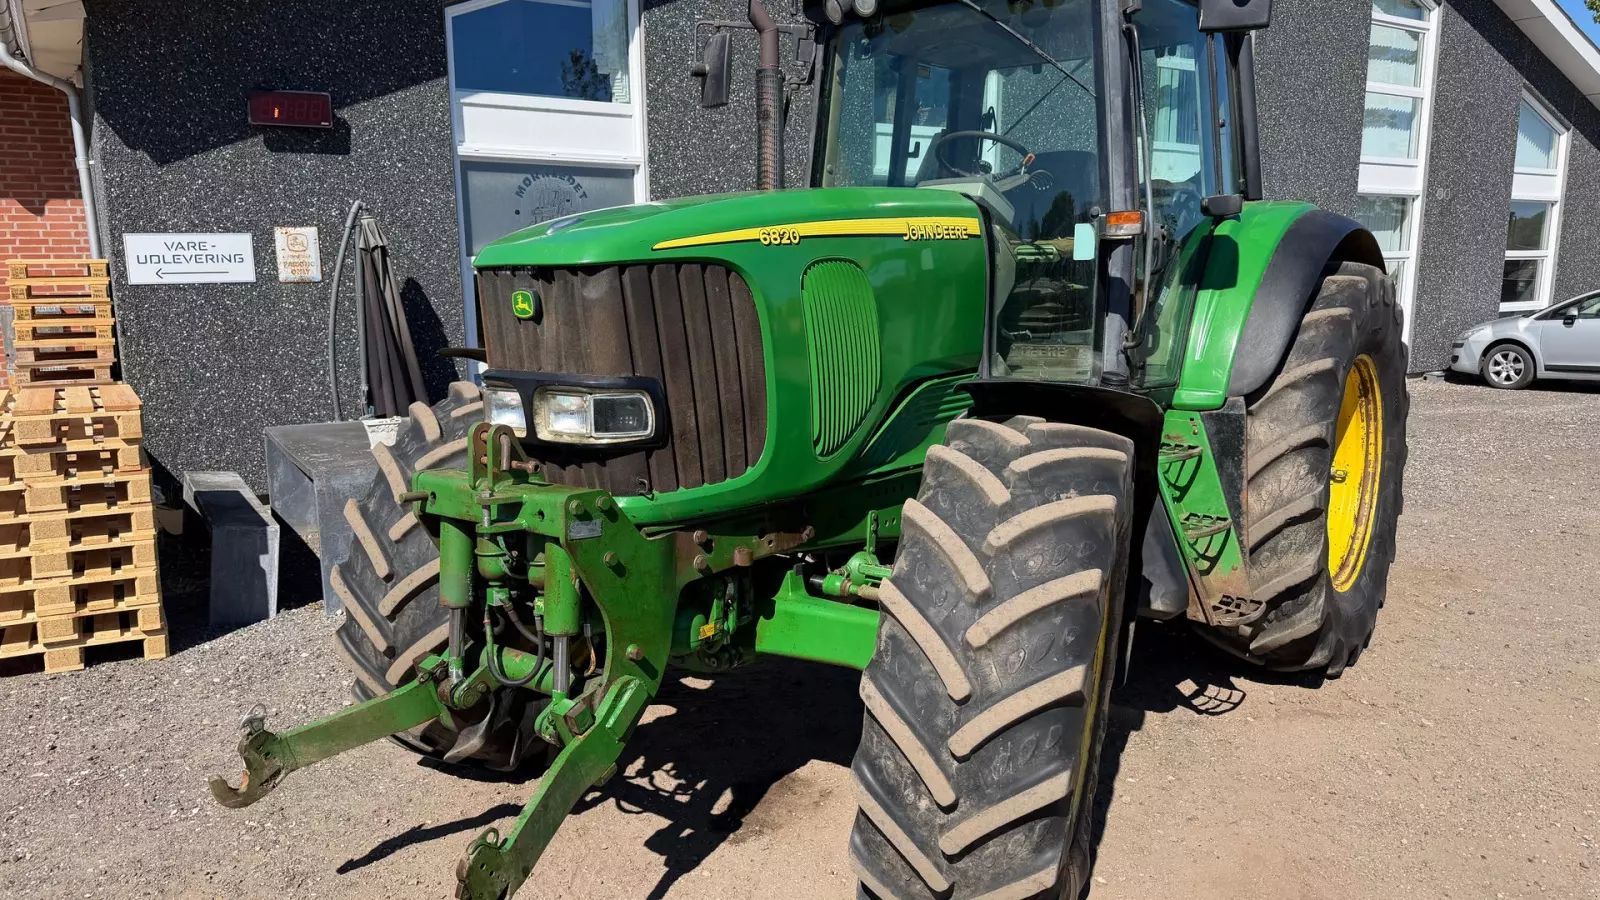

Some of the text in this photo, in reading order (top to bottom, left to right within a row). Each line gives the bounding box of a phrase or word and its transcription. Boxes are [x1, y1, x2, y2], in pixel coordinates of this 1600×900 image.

[759, 228, 800, 245] 6820
[903, 222, 969, 240] JOHN DEERE
[136, 253, 245, 265] UDLEVERING
